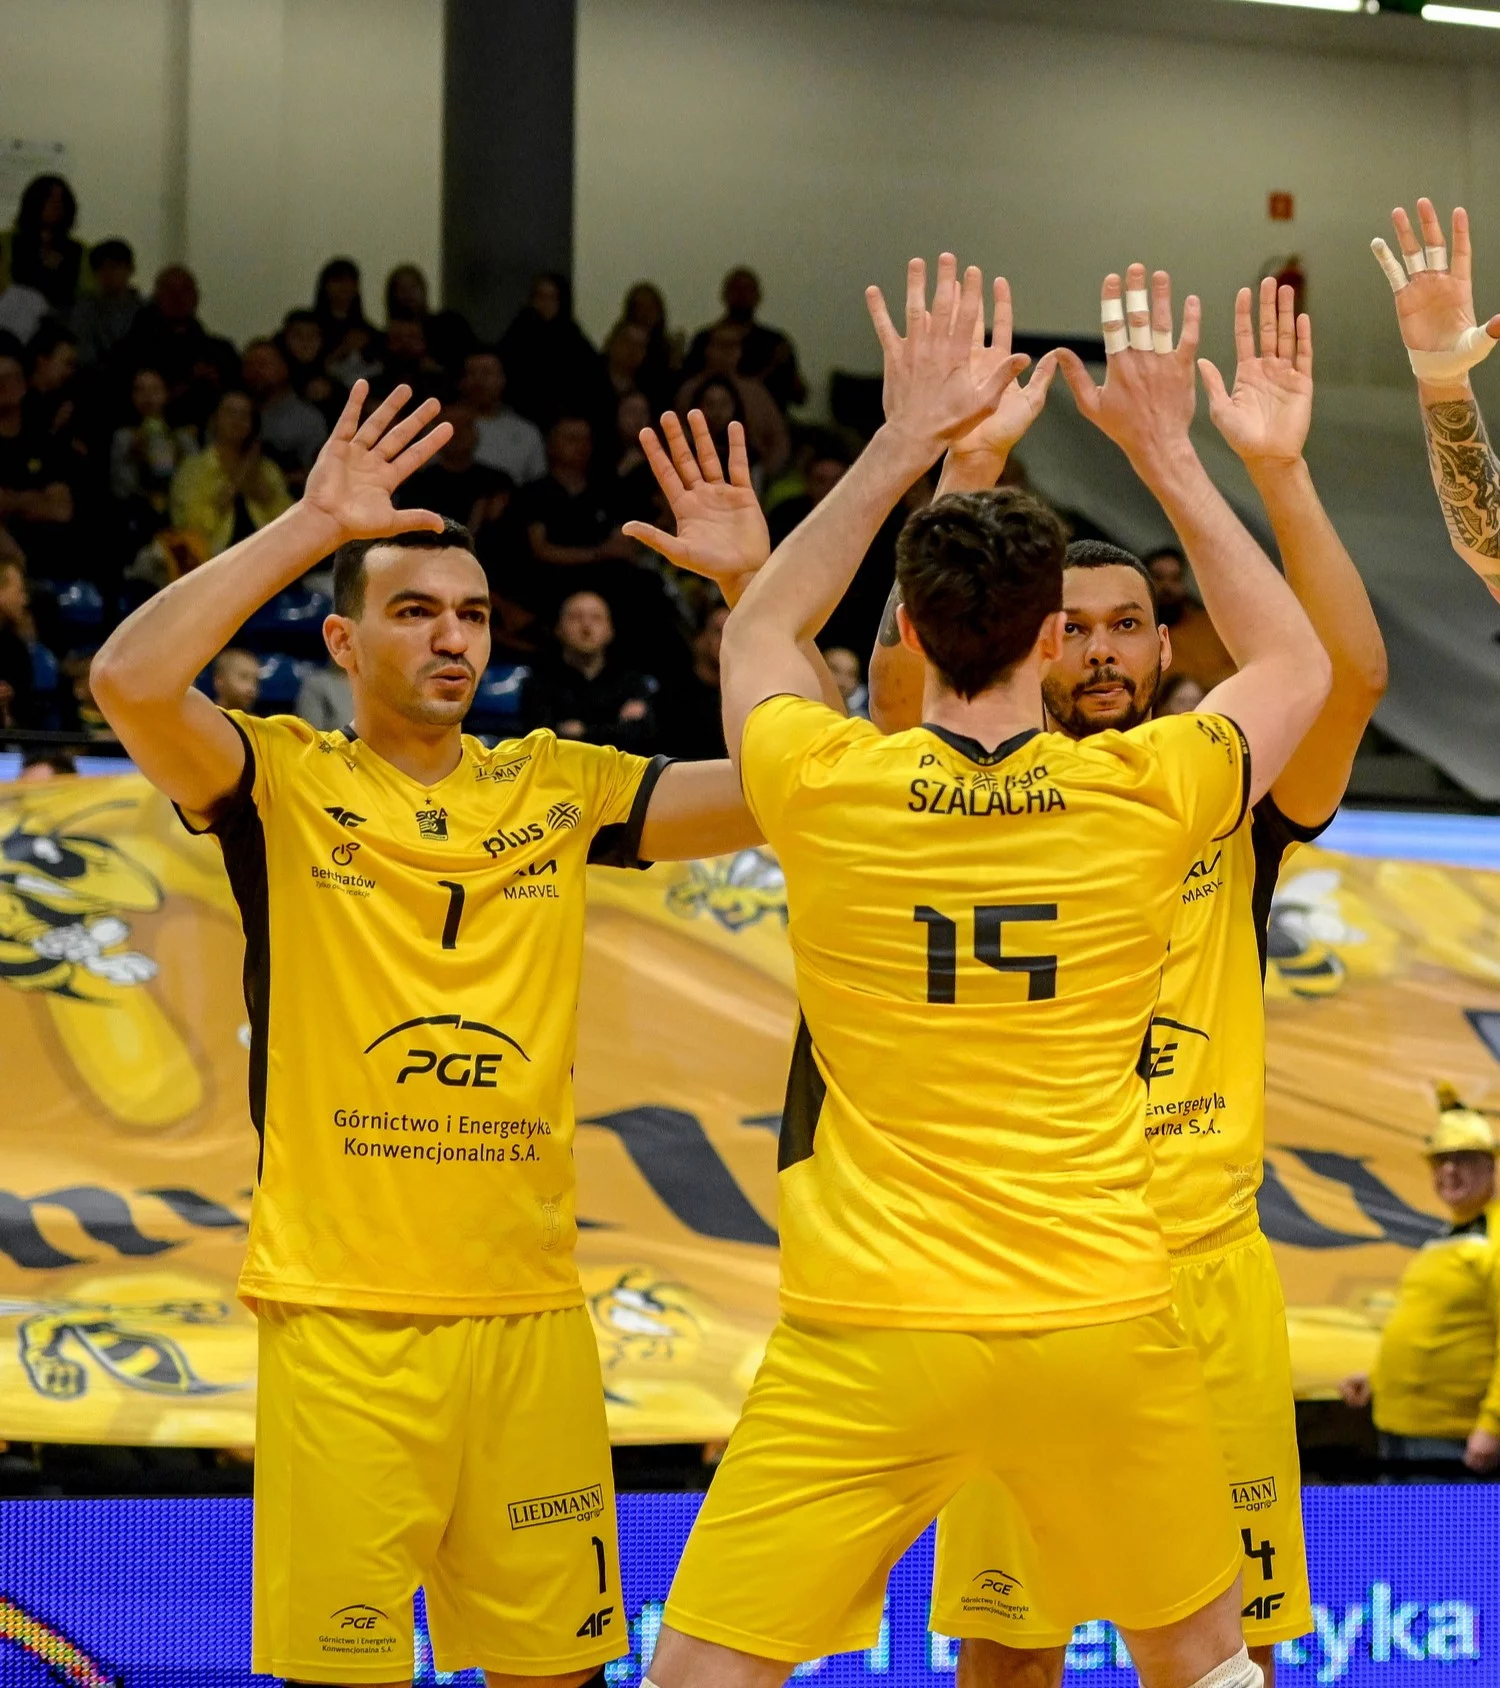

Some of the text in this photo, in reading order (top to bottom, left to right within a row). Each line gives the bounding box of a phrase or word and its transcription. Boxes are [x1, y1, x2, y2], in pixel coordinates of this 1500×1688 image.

[908, 778, 1067, 816] SZALACHA
[482, 822, 544, 859] plus
[503, 884, 559, 900] MARVEL
[438, 880, 465, 950] 1
[913, 903, 1058, 1004] 15
[396, 1049, 503, 1088] PGE
[334, 1109, 552, 1139] Górnictwo i Energetyka
[1189, 1118, 1221, 1135] S.A.
[344, 1137, 541, 1165] Konwencjonalna S.A.
[512, 1489, 600, 1524] LIEDMANN
[591, 1535, 607, 1595] 1
[981, 1578, 1013, 1596] PGE
[1241, 1592, 1285, 1620] 4F
[341, 1617, 378, 1629] PGE
[576, 1606, 614, 1638] 4F
[319, 1635, 355, 1644] Górnictwo
[361, 1637, 397, 1646] Energetyka
[322, 1644, 379, 1654] Konwencjonalna
